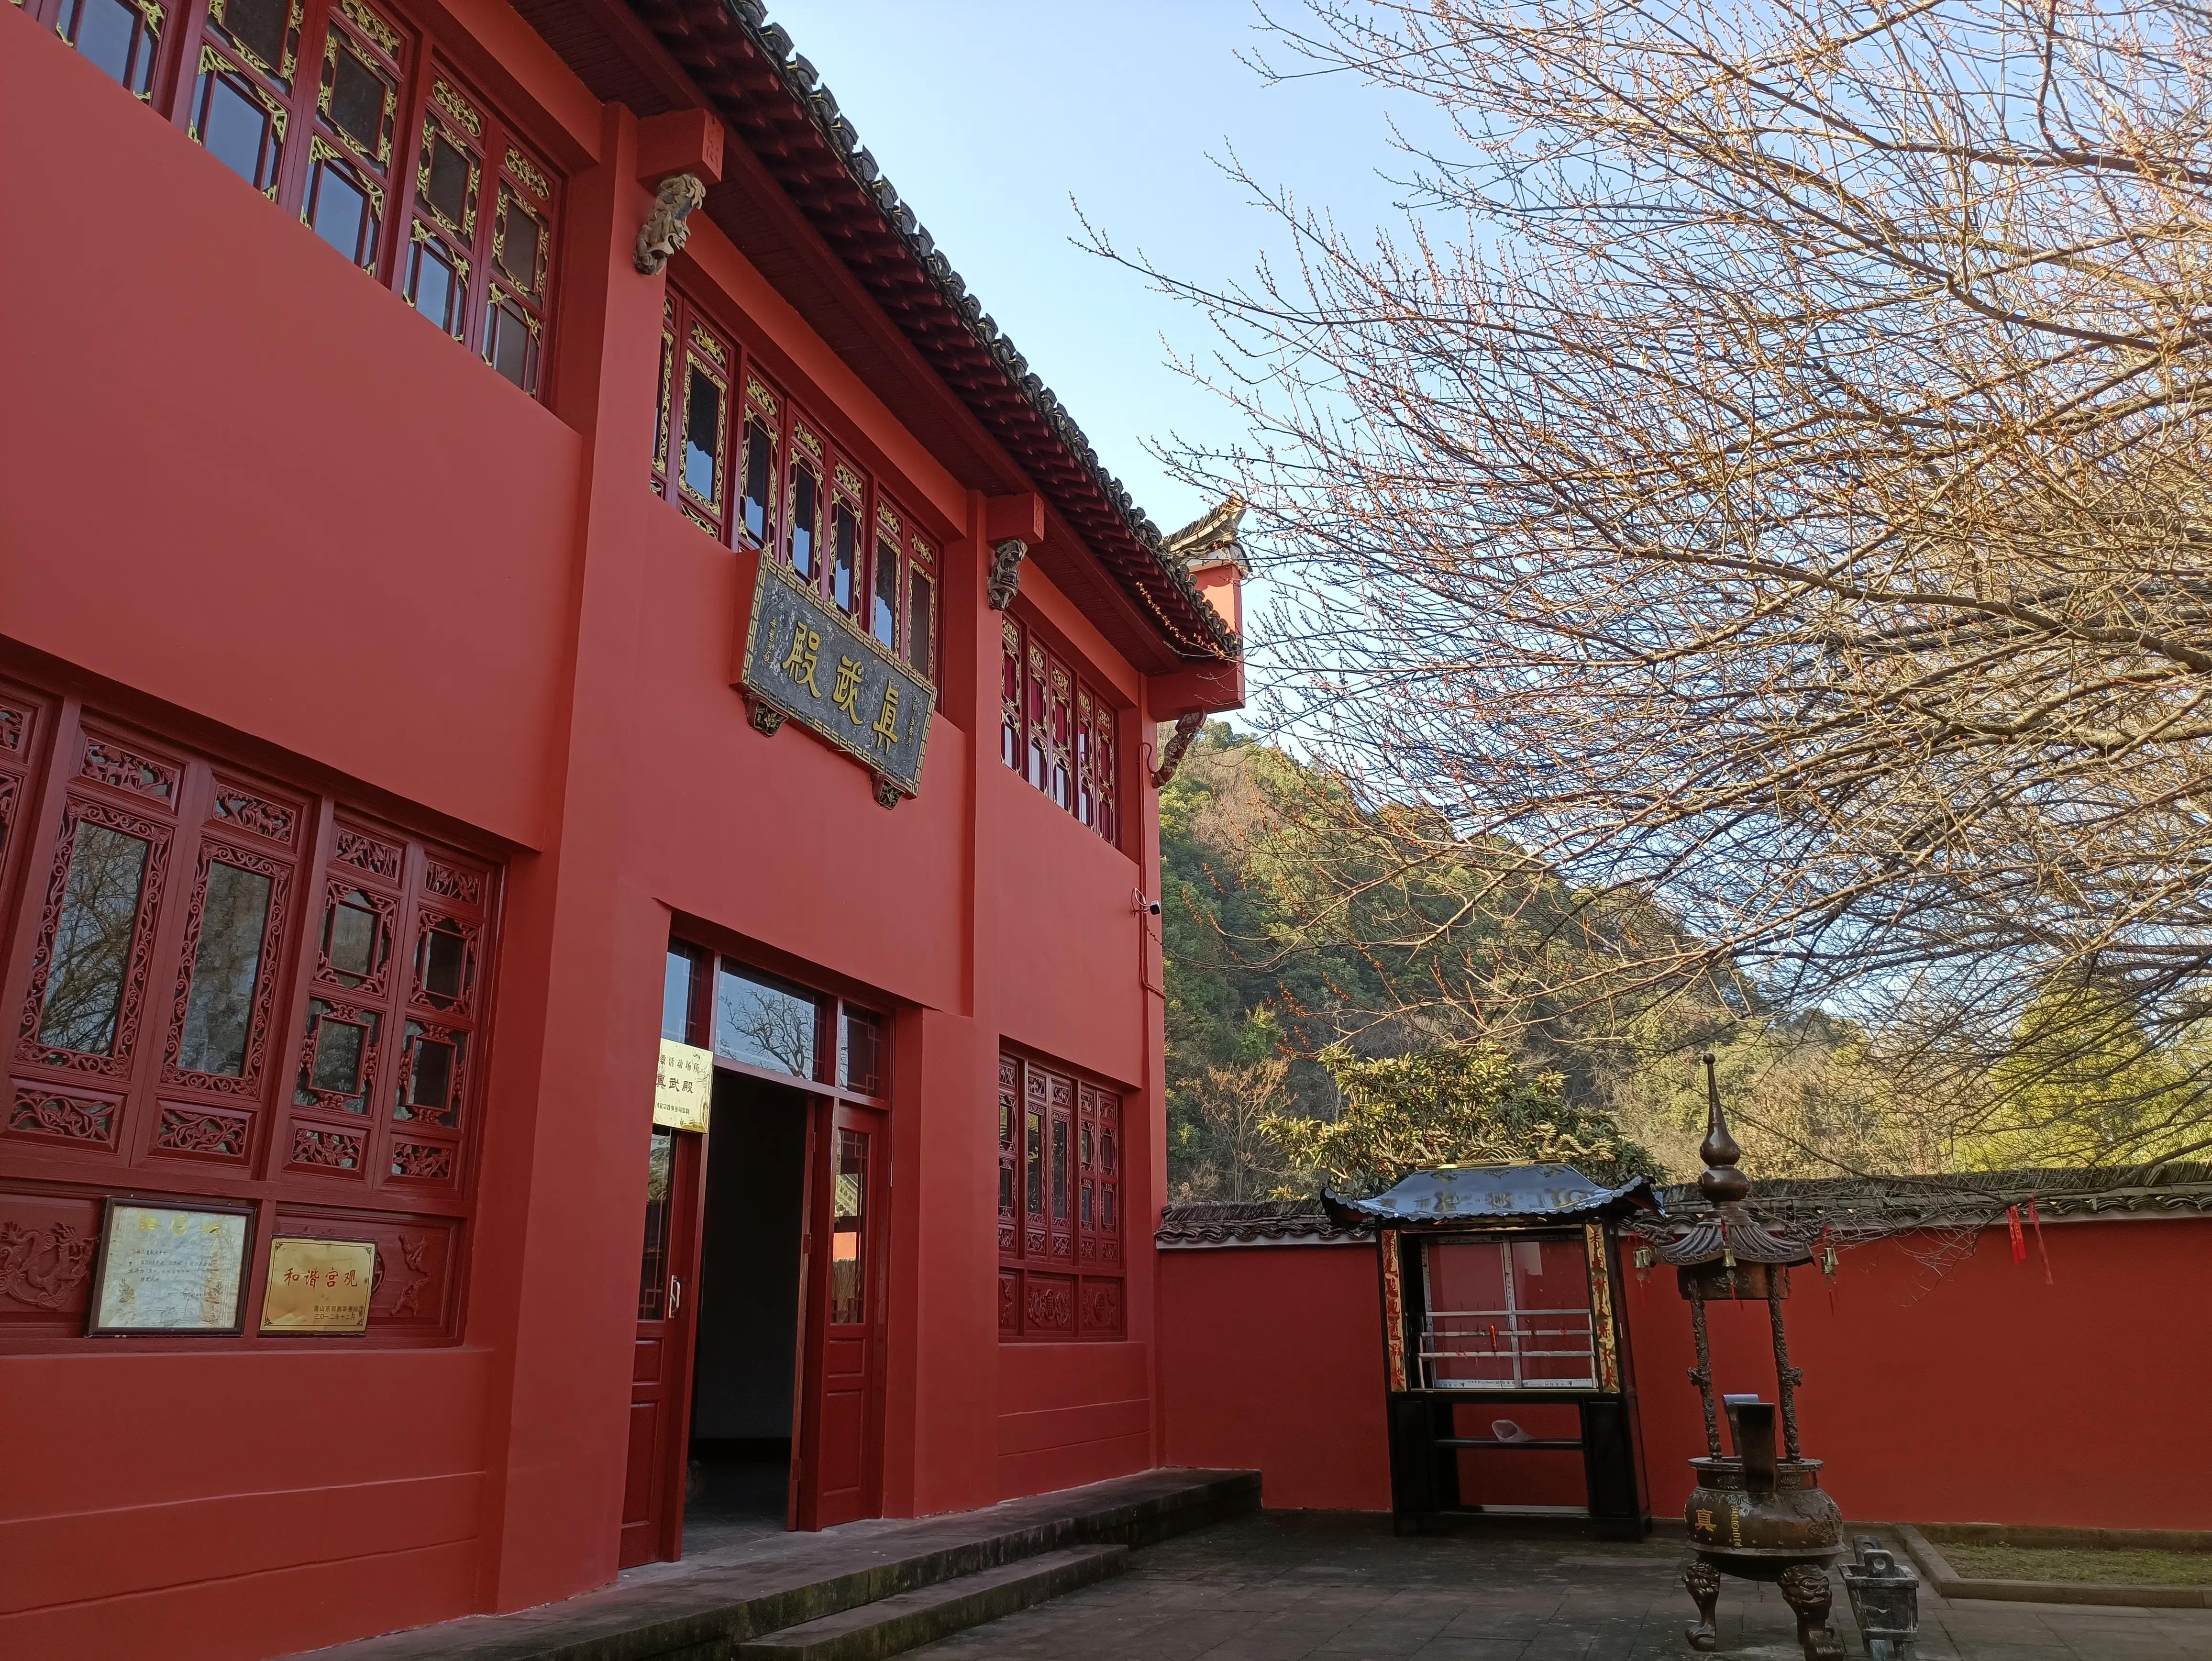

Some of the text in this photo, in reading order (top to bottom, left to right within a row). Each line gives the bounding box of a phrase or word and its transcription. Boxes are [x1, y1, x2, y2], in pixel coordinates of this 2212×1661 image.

[656, 1073, 694, 1094] 真武殿
[284, 1267, 358, 1290] 和谐宫观
[1695, 1508, 1717, 1532] 真
